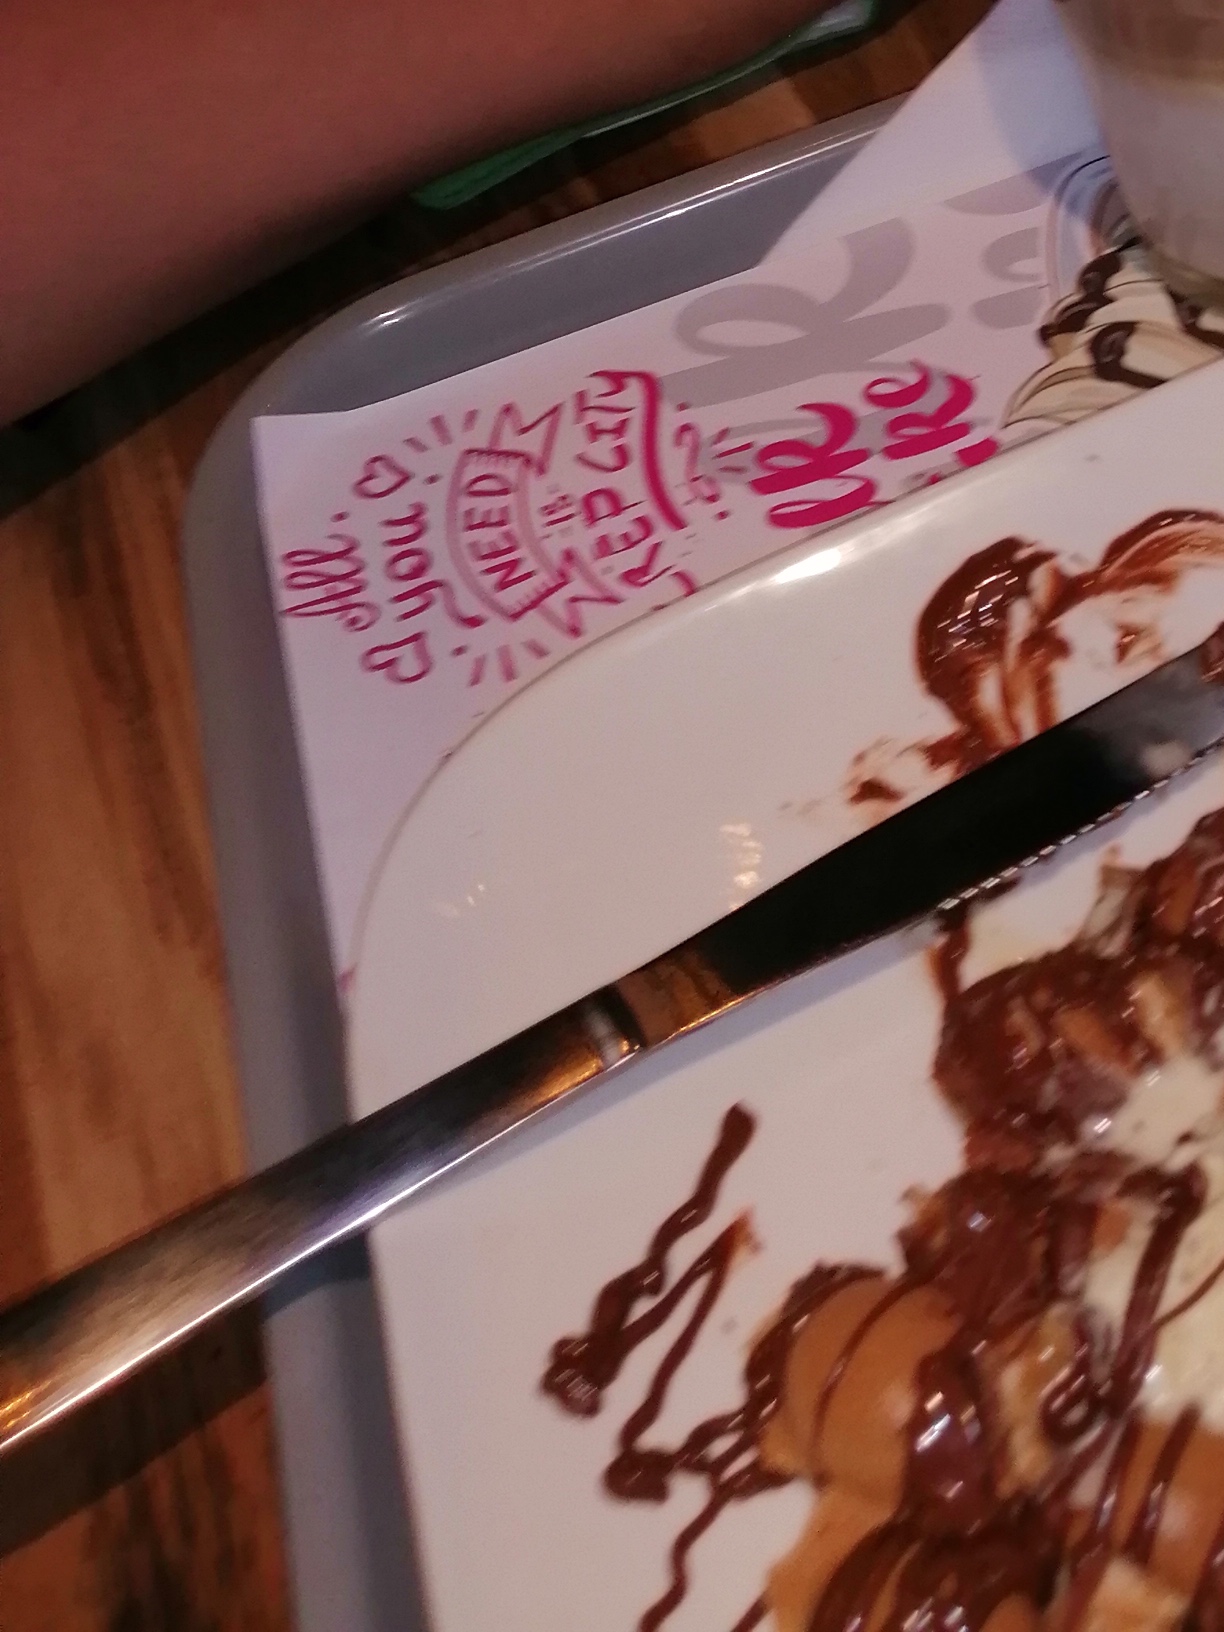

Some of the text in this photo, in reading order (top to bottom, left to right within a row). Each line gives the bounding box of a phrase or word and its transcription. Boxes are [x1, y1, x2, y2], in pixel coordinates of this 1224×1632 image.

[461, 472, 536, 593] NEED
[574, 370, 699, 601] REP CITY
[280, 532, 382, 632] All
[379, 500, 487, 630] you
